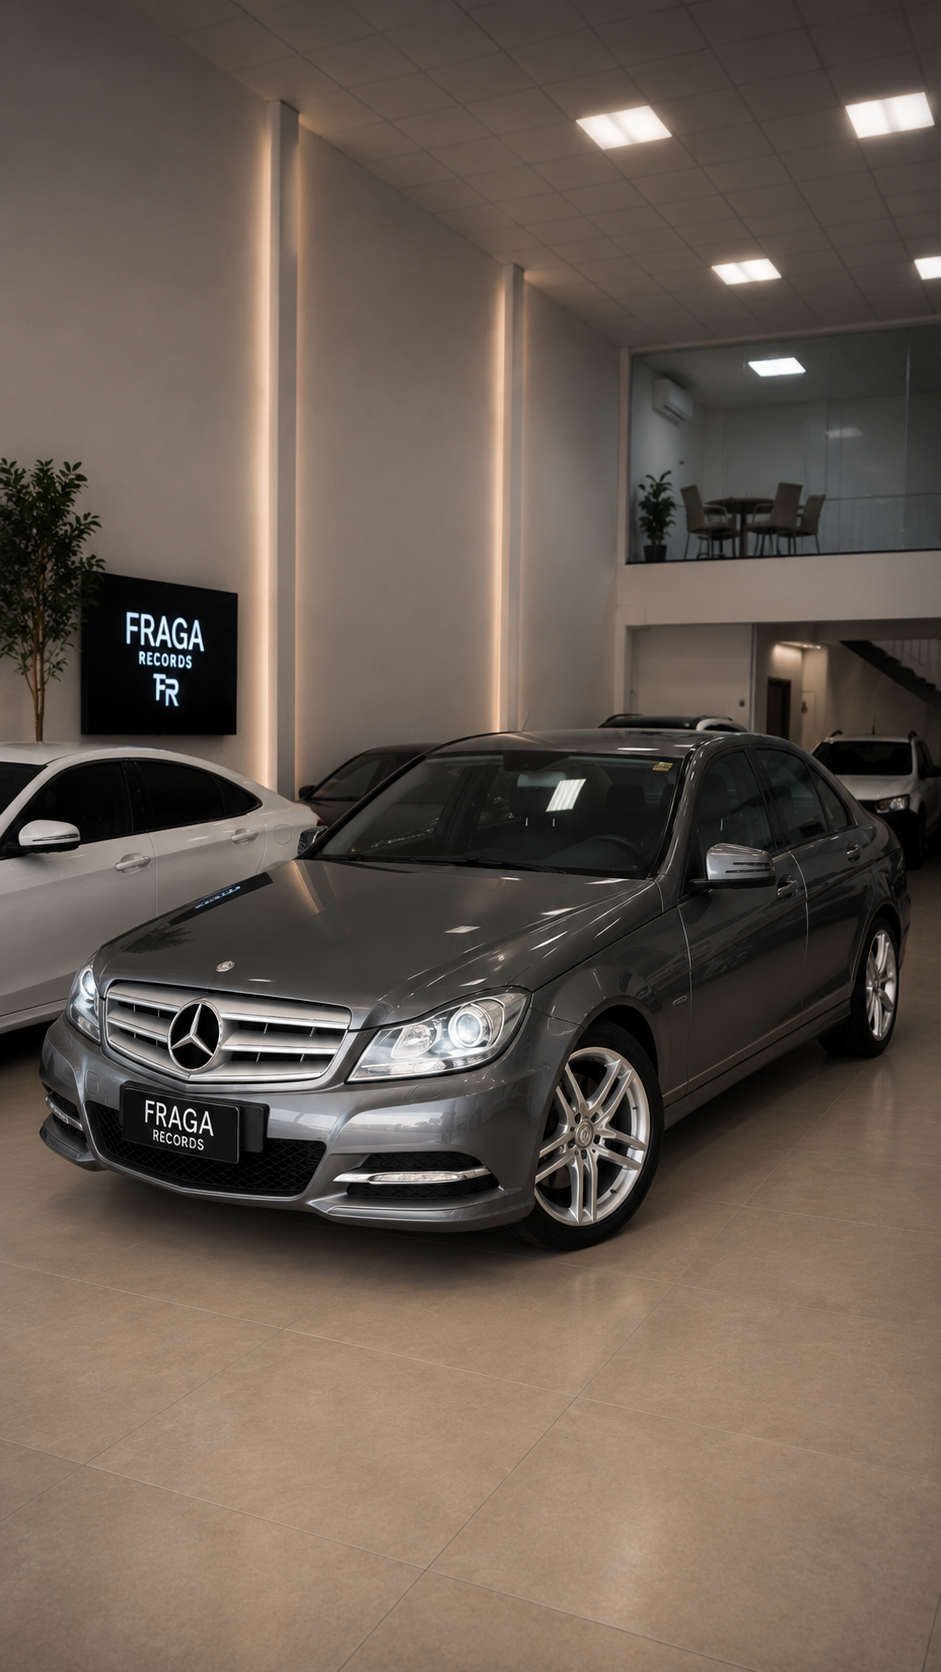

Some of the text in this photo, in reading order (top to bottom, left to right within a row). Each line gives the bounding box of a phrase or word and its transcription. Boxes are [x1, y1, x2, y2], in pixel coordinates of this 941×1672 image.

[126, 611, 205, 652] FRAGA
[138, 650, 193, 669] RECORDS
[144, 1099, 214, 1137] FRAGA
[152, 1128, 205, 1151] RECORDS
